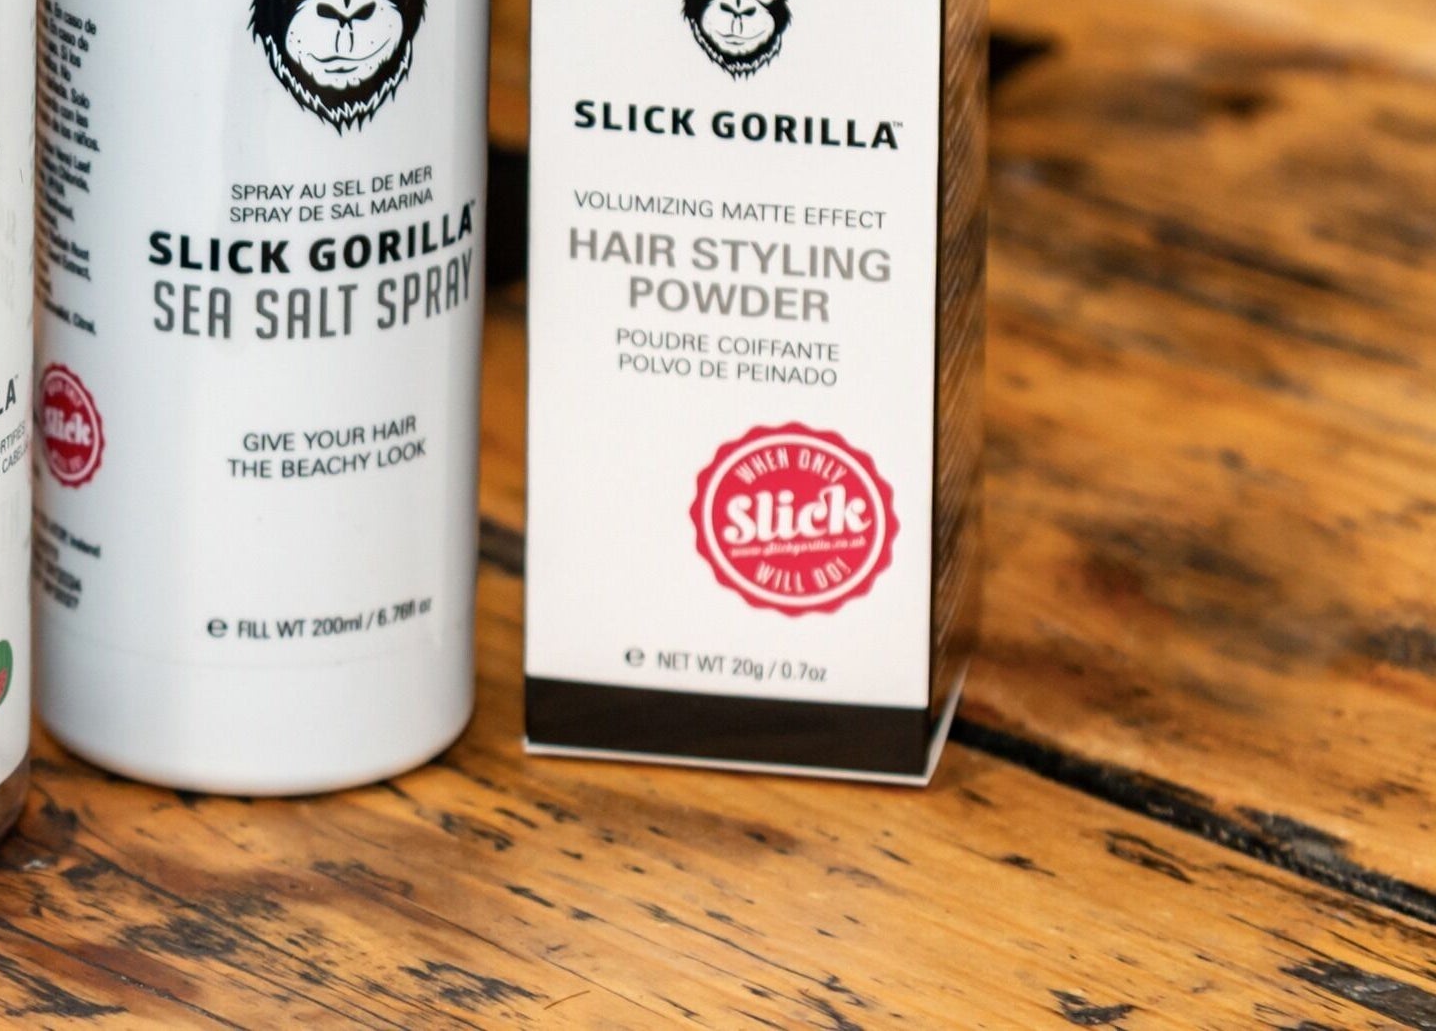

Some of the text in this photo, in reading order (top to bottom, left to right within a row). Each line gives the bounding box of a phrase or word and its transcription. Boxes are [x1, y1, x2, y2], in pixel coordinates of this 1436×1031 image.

[574, 99, 696, 137] SLICK
[231, 165, 433, 201] SPRAY AU SEL DE MER
[230, 187, 433, 223] SPRAY DE SAL MARINA
[574, 190, 887, 230] VOLUMIZING MATTE EFFECT
[148, 230, 290, 274] SLICK
[569, 226, 892, 284] HAIR STYLING
[153, 280, 232, 339] SEA
[255, 283, 359, 340] SALT
[377, 247, 472, 330] SPRAY
[628, 275, 831, 323] POWDER
[616, 328, 841, 362] POUDRE COIFFANTE
[619, 353, 839, 387] POLVO DE PEINADO
[243, 415, 417, 452] GIVE YOUR HAIR
[228, 438, 427, 478] THE BEACHY LOOK
[735, 447, 849, 485] WHEN ONLY
[722, 484, 872, 545] Slick
[755, 559, 806, 593] WILL
[237, 620, 271, 639] FILL
[276, 619, 307, 638] WT
[312, 614, 363, 637] 200ml
[657, 651, 692, 671] NET
[697, 655, 727, 674] WT
[732, 658, 764, 680] 20g
[768, 660, 777, 680] /
[781, 662, 827, 683] 0.7oz
